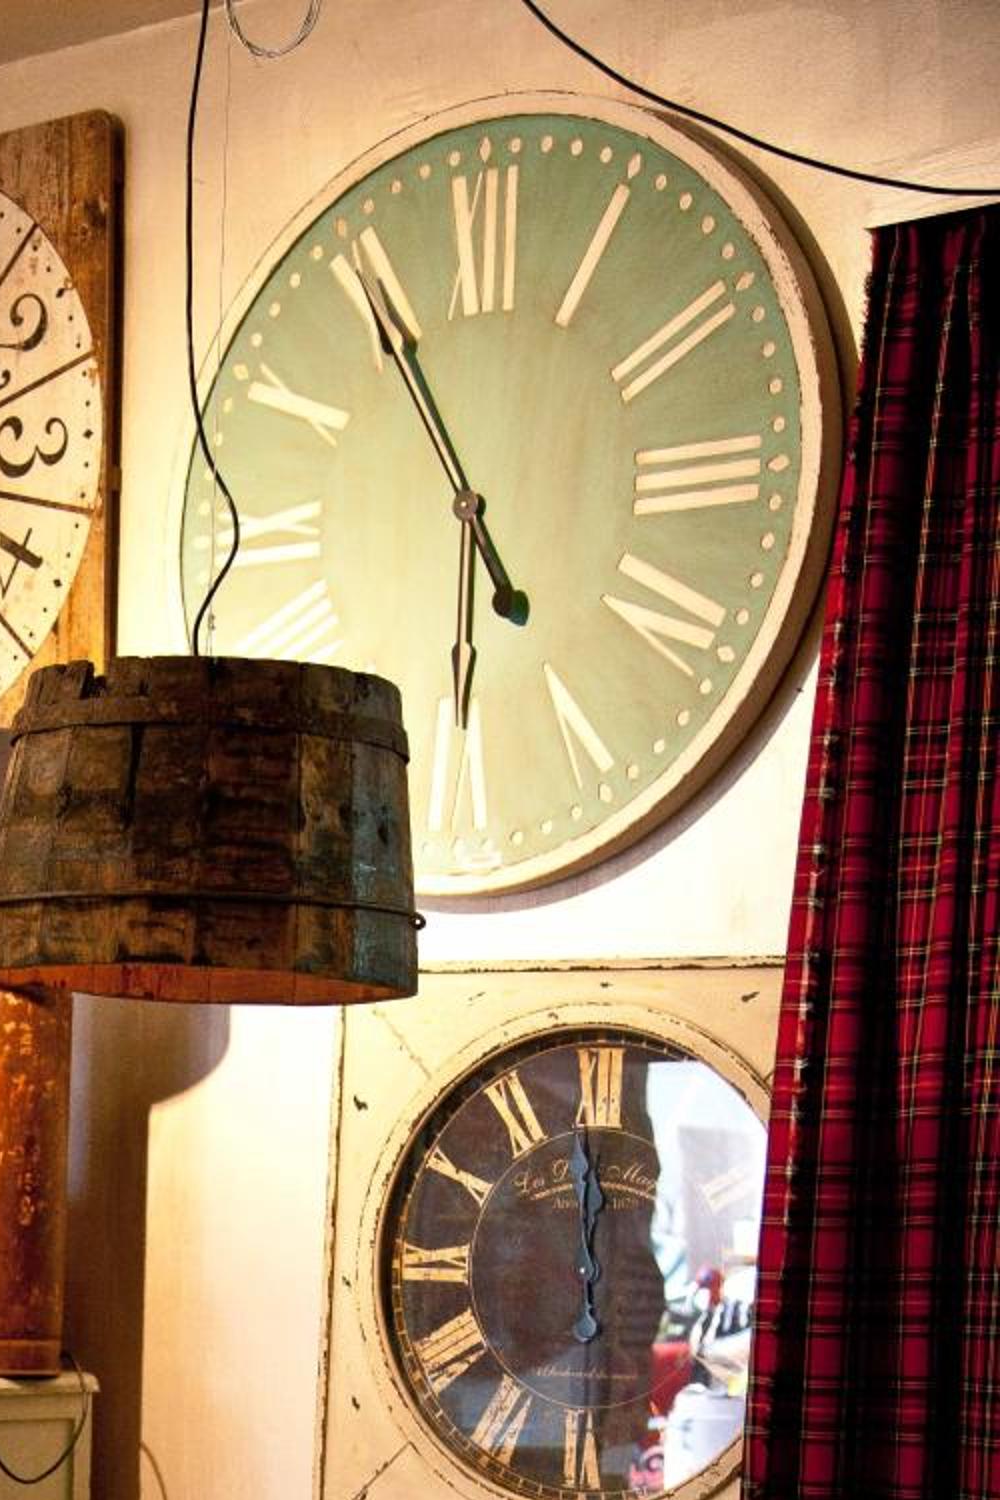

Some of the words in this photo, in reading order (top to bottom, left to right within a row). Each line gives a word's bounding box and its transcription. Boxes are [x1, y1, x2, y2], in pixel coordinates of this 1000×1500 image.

[448, 163, 520, 321] XII
[554, 183, 631, 328] I
[609, 279, 737, 403] II
[246, 361, 351, 448] X
[633, 434, 763, 516] III
[543, 659, 615, 791] V
[484, 1069, 549, 1161] XI
[572, 1046, 626, 1131] XII
[425, 1145, 495, 1209] X
[402, 1242, 470, 1285] IX
